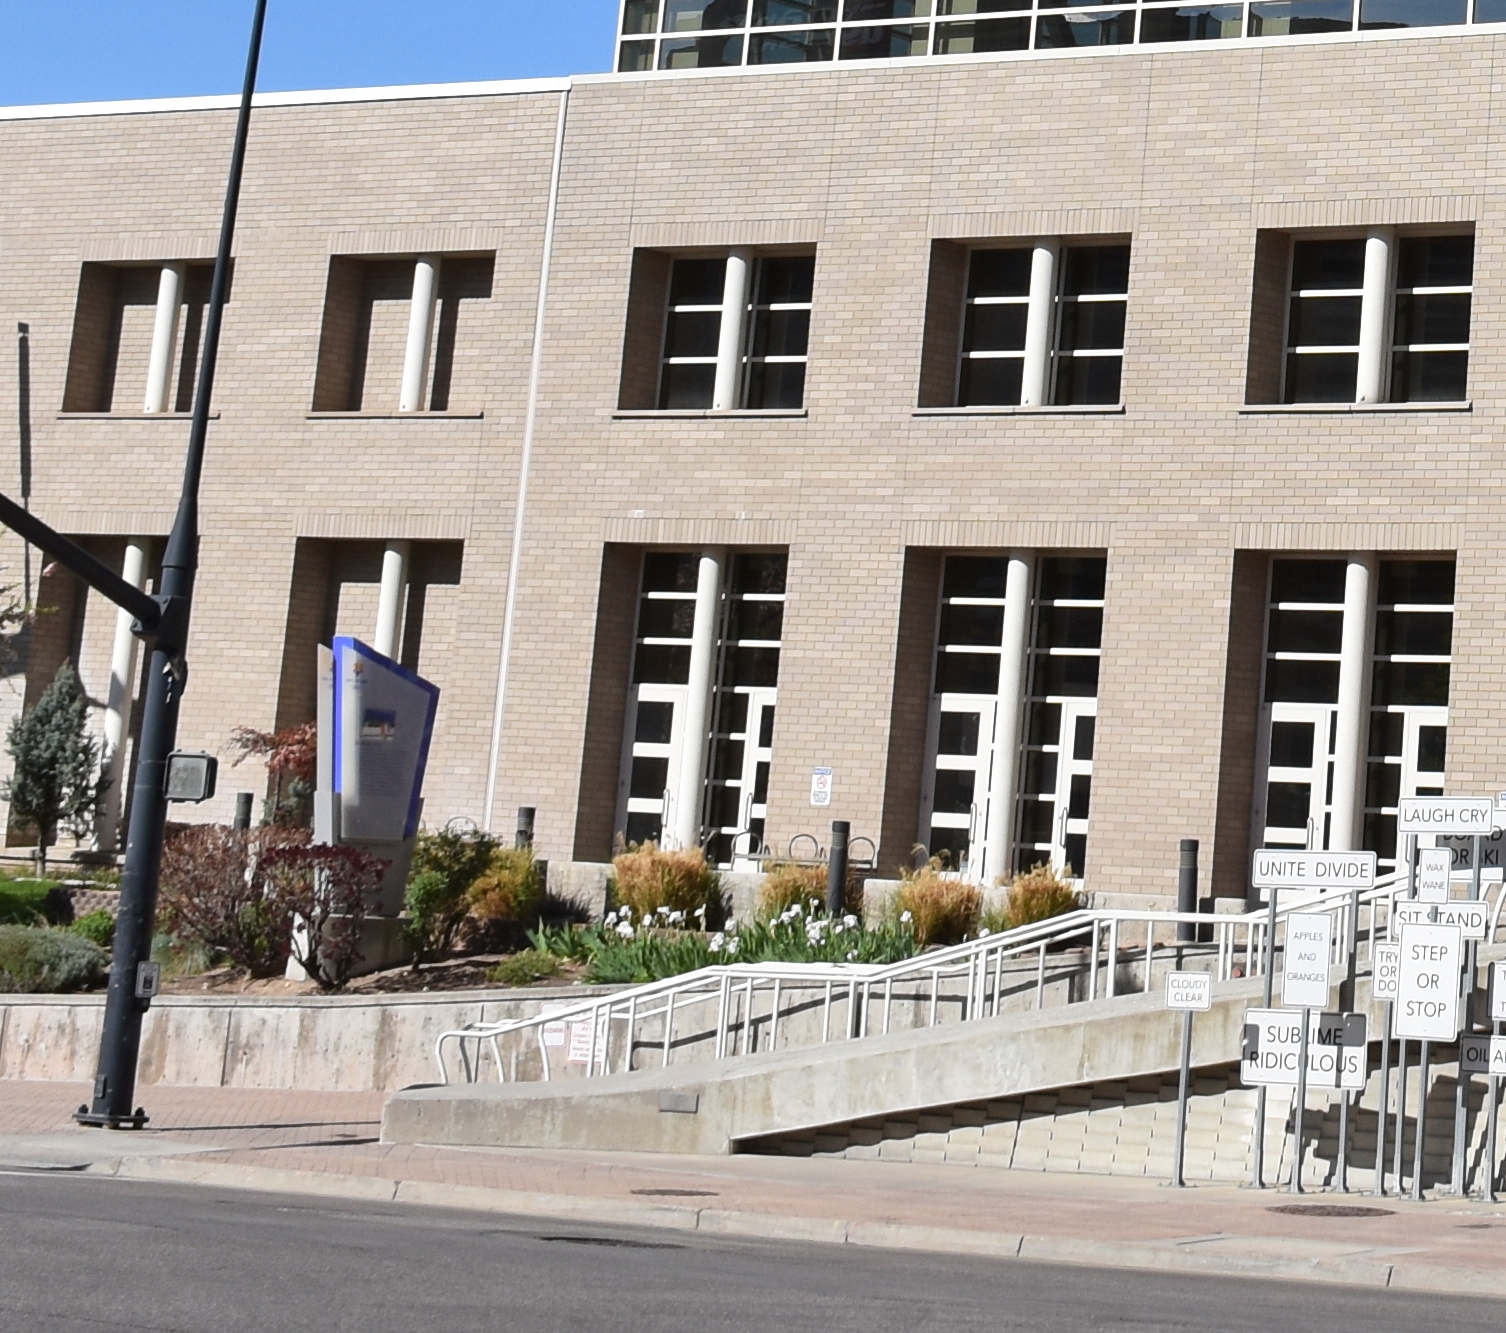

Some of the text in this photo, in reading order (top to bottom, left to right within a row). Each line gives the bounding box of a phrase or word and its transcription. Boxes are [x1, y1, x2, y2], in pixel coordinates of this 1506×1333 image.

[1404, 809, 1488, 822] LAUGH CRY
[1293, 932, 1323, 941] APPLES
[1287, 972, 1325, 982] ORANGES
[1171, 979, 1207, 989] CLOUDY
[1174, 992, 1203, 1002] CLEAR
[1406, 1002, 1446, 1017] STOP
